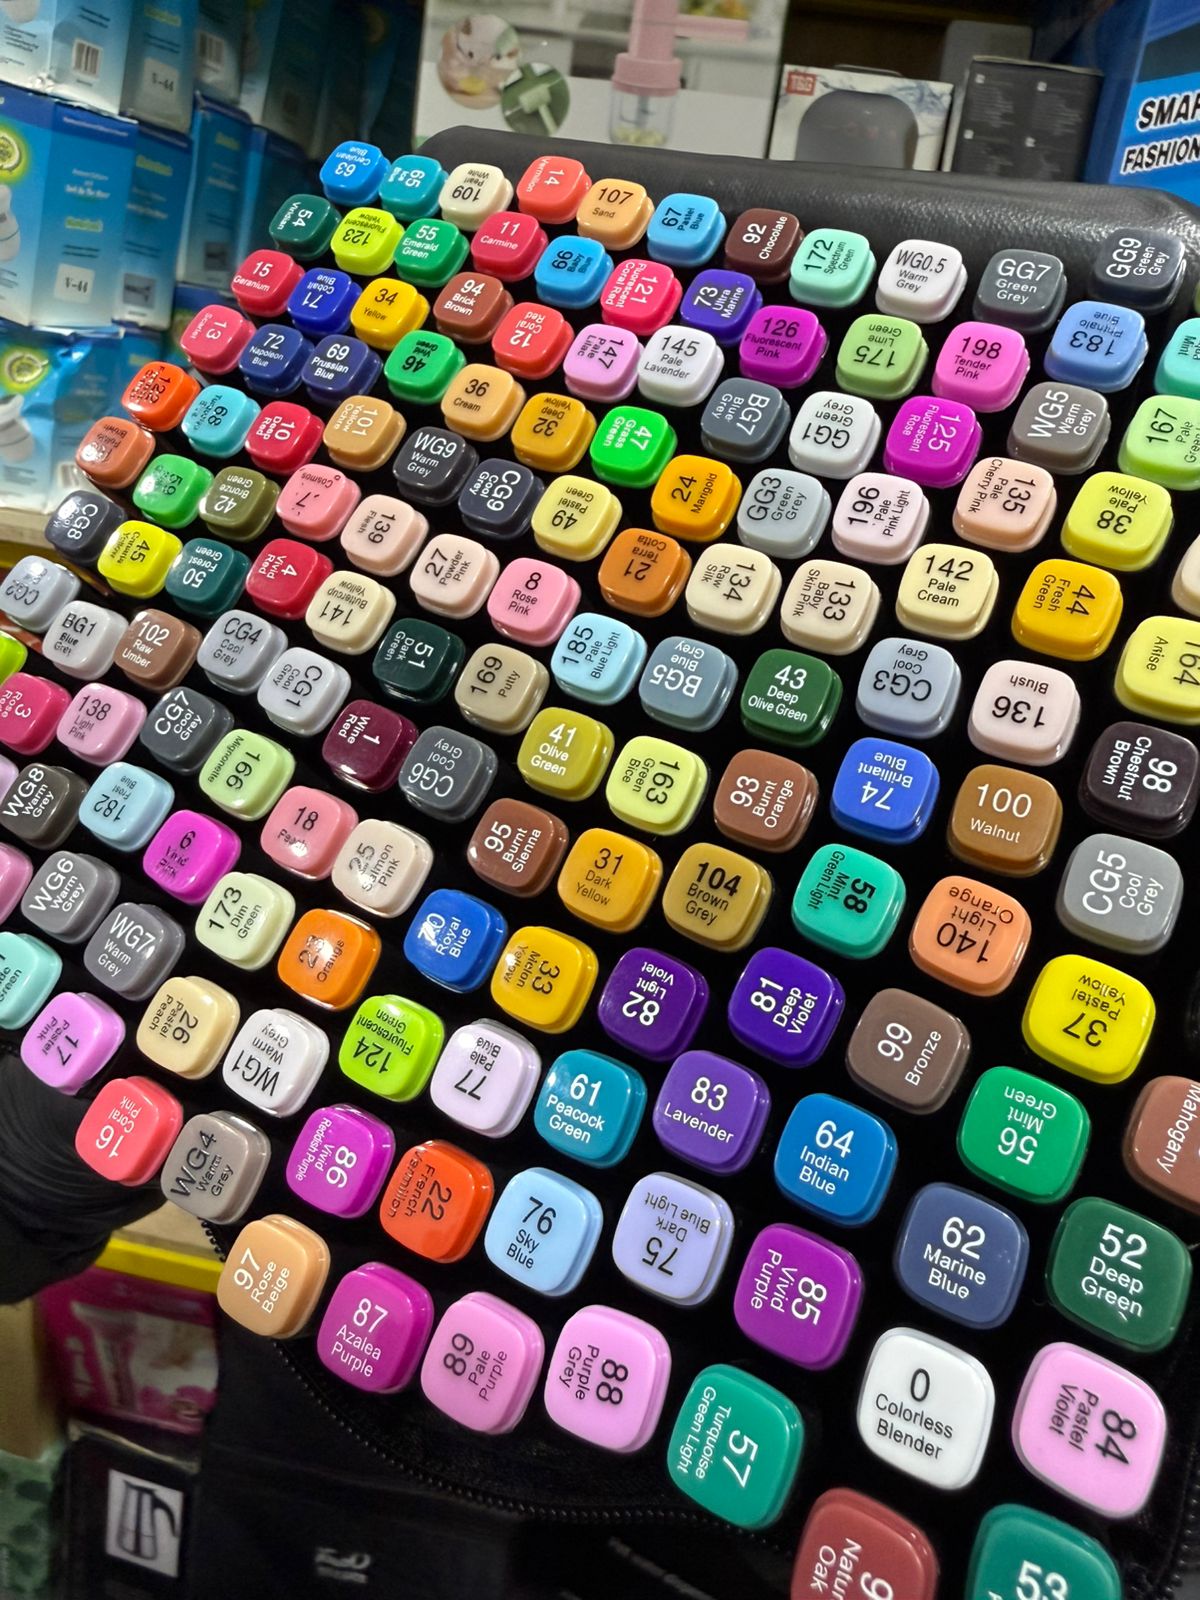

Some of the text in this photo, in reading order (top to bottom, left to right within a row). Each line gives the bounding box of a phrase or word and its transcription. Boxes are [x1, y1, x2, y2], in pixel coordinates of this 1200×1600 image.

[1121, 136, 1200, 173] FASHION
[598, 187, 634, 205] 107
[592, 208, 616, 218] Sand
[662, 207, 681, 228] 67
[678, 207, 694, 231] Pastel
[691, 212, 704, 230] Blue
[416, 225, 439, 240] 55
[480, 235, 518, 250] Carmine
[499, 221, 520, 237] 11
[743, 223, 767, 244] 92
[759, 215, 787, 260] Chocolate
[402, 239, 438, 252] Emerald
[402, 247, 429, 259] Green
[253, 261, 273, 277] 15
[895, 249, 947, 274] WG0.5
[898, 269, 928, 283] Warm
[997, 258, 1051, 281] GG7
[233, 275, 270, 292] Geranium
[374, 289, 398, 306] 34
[460, 279, 485, 296] 94
[606, 262, 636, 306] Coral Red
[615, 263, 647, 308] Fluorescent
[631, 275, 659, 305] 121
[896, 279, 921, 293] Grey
[996, 279, 1037, 293] Green
[997, 290, 1029, 305] Grey
[364, 307, 387, 320] Yellow
[444, 301, 472, 316] Brown
[452, 293, 476, 306] Brick
[263, 333, 285, 350] 72
[745, 334, 802, 351] Fluorescent
[763, 318, 799, 338] 126
[867, 334, 895, 347] Lime
[869, 323, 902, 337] Green
[250, 346, 283, 361] Napoleon
[326, 343, 350, 361] 69
[660, 354, 683, 366] Pale
[661, 335, 700, 357] 145
[755, 347, 780, 359] Pink
[854, 345, 896, 368] 175
[252, 356, 269, 367] Blue
[311, 356, 349, 373] Prussian
[314, 367, 334, 380] Blue
[644, 362, 690, 379] Lavender
[465, 379, 490, 397] 36
[453, 398, 481, 412] Cream
[712, 393, 732, 420] Grey
[725, 396, 744, 422] Blue
[736, 393, 770, 436] BG7
[1027, 389, 1069, 439] WG5
[1056, 402, 1081, 435] Warm
[1074, 409, 1096, 436] Grey
[411, 451, 439, 467] Warm
[414, 432, 458, 458] WG9
[407, 462, 432, 477] Grey
[671, 474, 697, 503] 24
[691, 473, 718, 514] Marigold
[188, 557, 218, 573] Forest
[195, 545, 222, 561] Green
[424, 548, 449, 578] 27
[439, 550, 464, 586] Powder
[924, 554, 974, 581] 142
[182, 568, 206, 588] 50
[453, 559, 471, 582] Pink
[928, 578, 957, 593] Pale
[917, 589, 959, 607] Cream
[1033, 574, 1057, 609] Green
[1047, 578, 1071, 612] Fresh
[1066, 584, 1096, 616] 44
[133, 639, 154, 655] Raw
[139, 621, 170, 646] 102
[122, 648, 152, 667] Umber
[774, 665, 807, 690] 43
[1010, 674, 1049, 695] Blush
[748, 695, 808, 723] Olive Green
[767, 685, 799, 705] Deep
[992, 695, 1047, 728] 136
[549, 722, 578, 748] 41
[207, 735, 245, 783] Mignonette
[530, 754, 567, 777] Green
[539, 742, 569, 762] Olive
[1102, 740, 1132, 785] Brown
[226, 751, 262, 791] 166
[1117, 735, 1152, 801] Chestnut
[1142, 758, 1178, 793] 98
[730, 775, 760, 808] 93
[752, 780, 777, 817] Burnt
[763, 778, 794, 829] Orange
[977, 782, 1033, 818] 100
[970, 817, 1021, 844] Walnut
[29, 857, 75, 913] WG6
[50, 874, 78, 910] Warm
[1082, 849, 1127, 915] CG5
[1119, 871, 1143, 908] Cool
[1137, 877, 1164, 916] Grey
[62, 882, 85, 913] Grey
[208, 886, 243, 932] 173
[230, 904, 248, 929] Dim
[237, 904, 262, 940] Green
[750, 977, 785, 1012] 81
[1071, 988, 1120, 1021] Pastel
[1079, 973, 1126, 1006] Yellow
[772, 986, 803, 1028] Deep
[787, 992, 819, 1035] Violet
[877, 1022, 913, 1062] 99
[1062, 1011, 1108, 1047] 37
[904, 1029, 943, 1087] Bronze
[570, 1073, 602, 1107] 61
[690, 1076, 729, 1111] 83
[108, 1108, 135, 1133] Coral
[119, 1096, 143, 1119] Pink
[546, 1095, 607, 1132] Peacock
[549, 1115, 592, 1144] Green
[663, 1102, 735, 1144] Lavender
[1156, 1083, 1200, 1174] Mahogany
[95, 1125, 125, 1158] 16
[815, 1120, 855, 1158] 64
[800, 1145, 850, 1181] Indian
[799, 1170, 836, 1195] Blue
[522, 1196, 557, 1236] 76
[515, 1228, 541, 1253] Sky
[941, 1215, 986, 1260] 62
[1099, 1223, 1148, 1270] 52
[233, 1248, 262, 1291] 97
[506, 1243, 535, 1270] Blue
[923, 1243, 987, 1286] Marine
[250, 1261, 278, 1303] Rose
[261, 1267, 290, 1314] Beige
[928, 1268, 970, 1300] Blue
[1089, 1256, 1144, 1295] Deep
[1080, 1275, 1144, 1318] Green
[353, 1298, 389, 1333] 87
[335, 1324, 383, 1361] Azalea
[330, 1342, 374, 1379] Purple
[558, 1346, 582, 1389] Grey
[575, 1343, 601, 1401] Purple
[595, 1358, 629, 1406] 88
[910, 1368, 931, 1402] 0
[875, 1392, 953, 1440] Colorless
[1048, 1382, 1080, 1437] Violet
[1067, 1388, 1100, 1452] Pastel
[671, 1386, 717, 1475] Green Light
[695, 1405, 732, 1480] Turquoise
[875, 1417, 944, 1460] Blender
[1095, 1408, 1137, 1466] 84
[722, 1429, 758, 1488] 57
[810, 1545, 836, 1593] Oak
